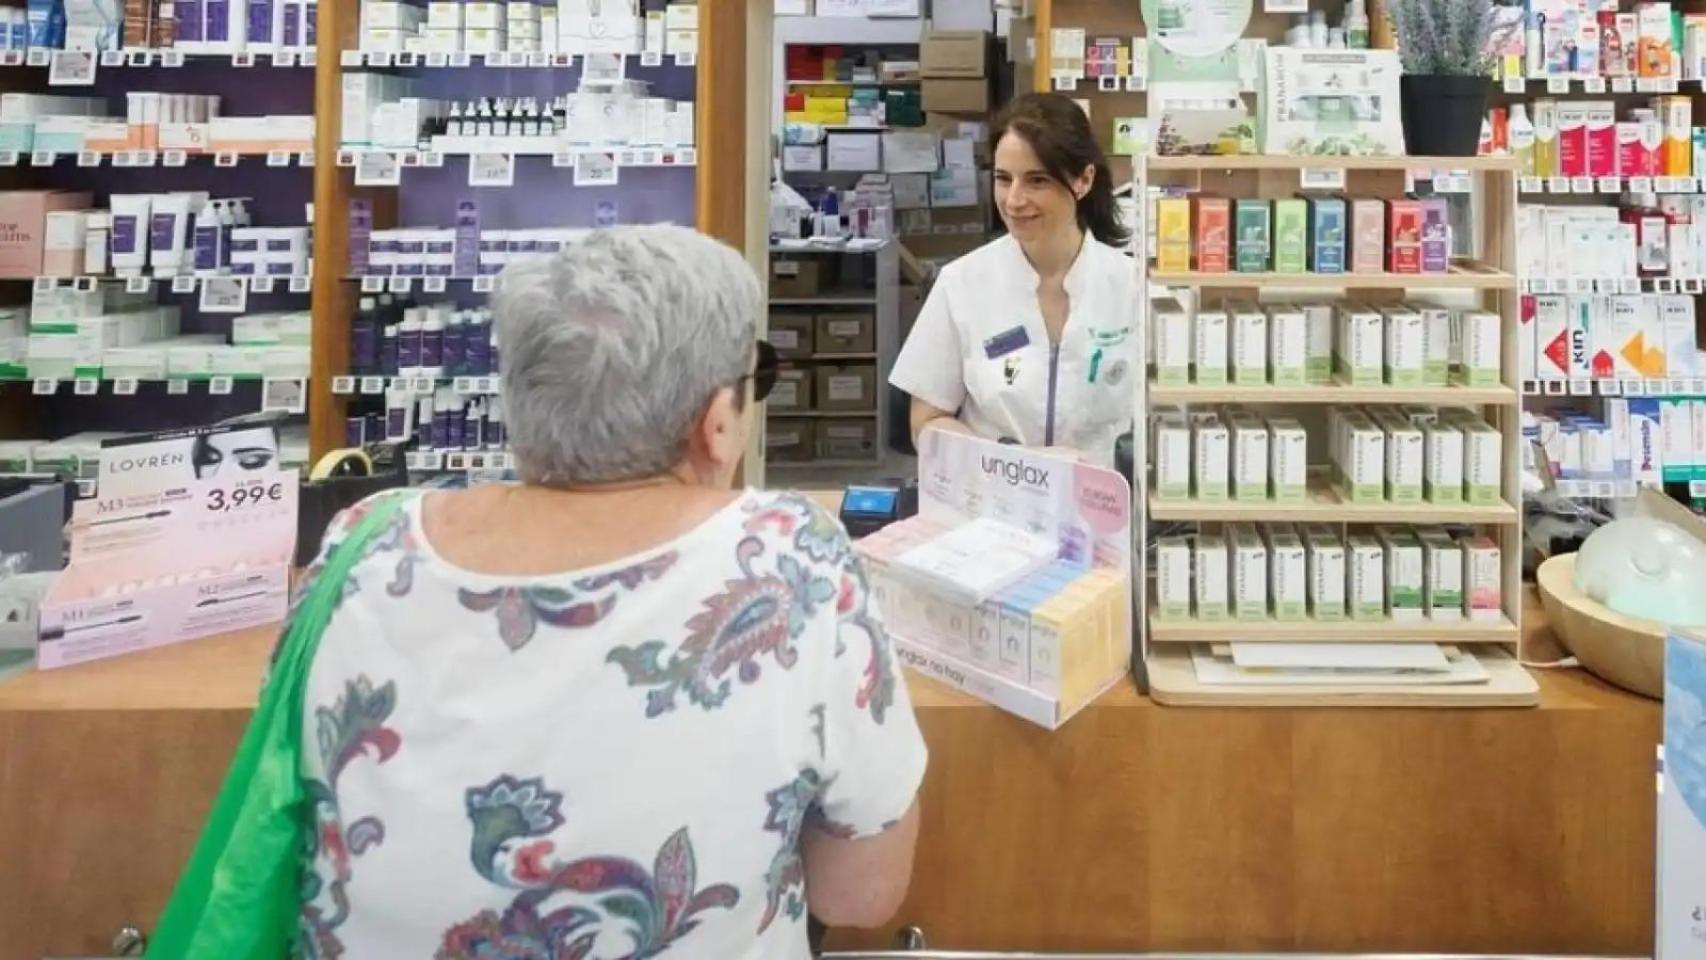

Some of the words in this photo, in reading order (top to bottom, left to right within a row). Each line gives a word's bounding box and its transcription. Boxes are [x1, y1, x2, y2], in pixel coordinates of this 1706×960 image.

[981, 454, 1049, 488] unglax
[98, 498, 123, 514] M3
[206, 482, 282, 512] 3,99€
[896, 647, 927, 667] nglax
